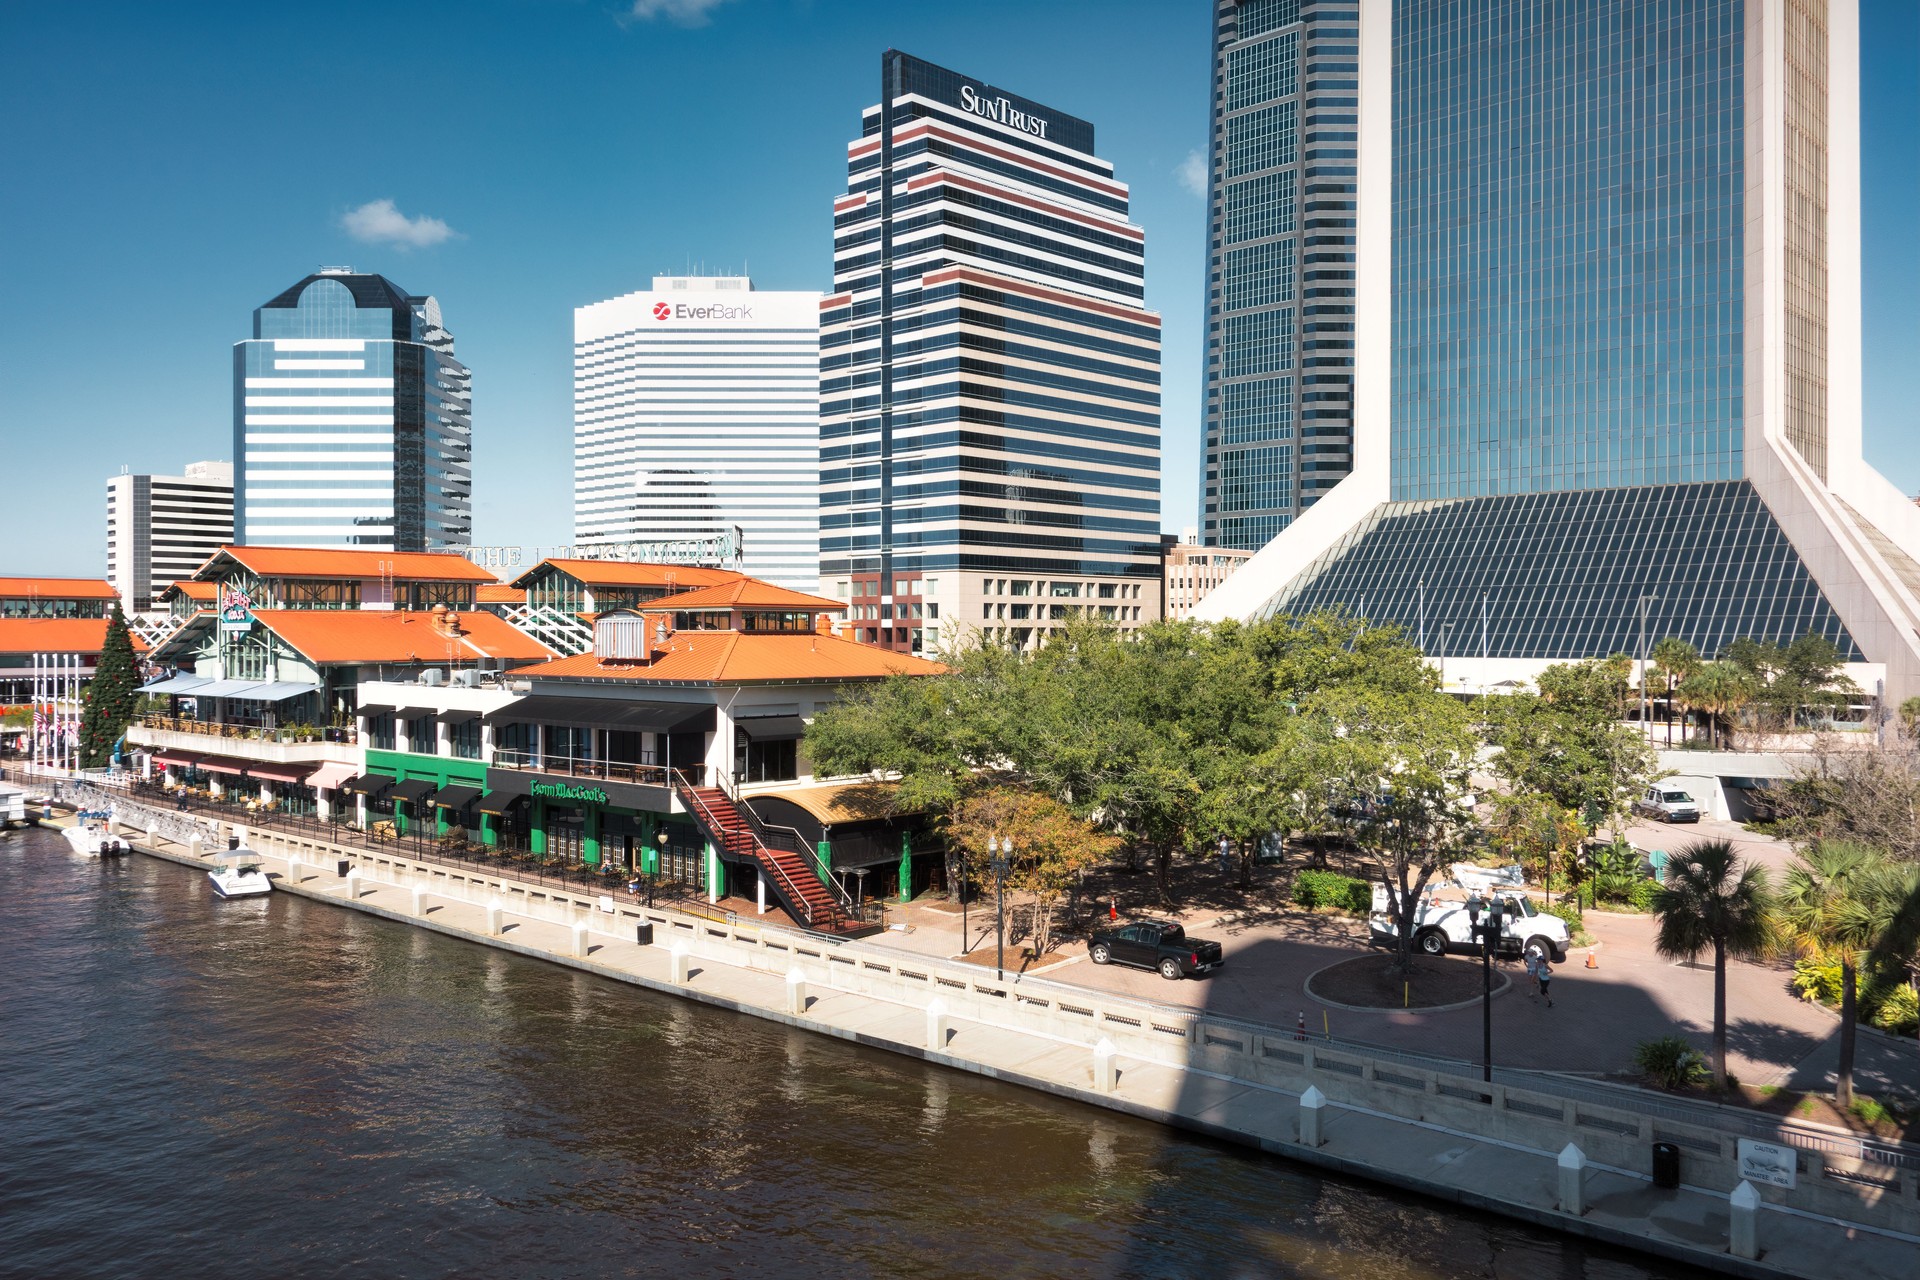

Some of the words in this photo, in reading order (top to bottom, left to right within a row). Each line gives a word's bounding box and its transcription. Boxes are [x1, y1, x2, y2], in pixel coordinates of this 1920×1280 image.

[675, 303, 753, 319] EverBank
[466, 546, 521, 567] THE
[1754, 1144, 1779, 1155] CAUTION
[1743, 1170, 1769, 1181] MANATEE
[1773, 1176, 1789, 1185] AREA
